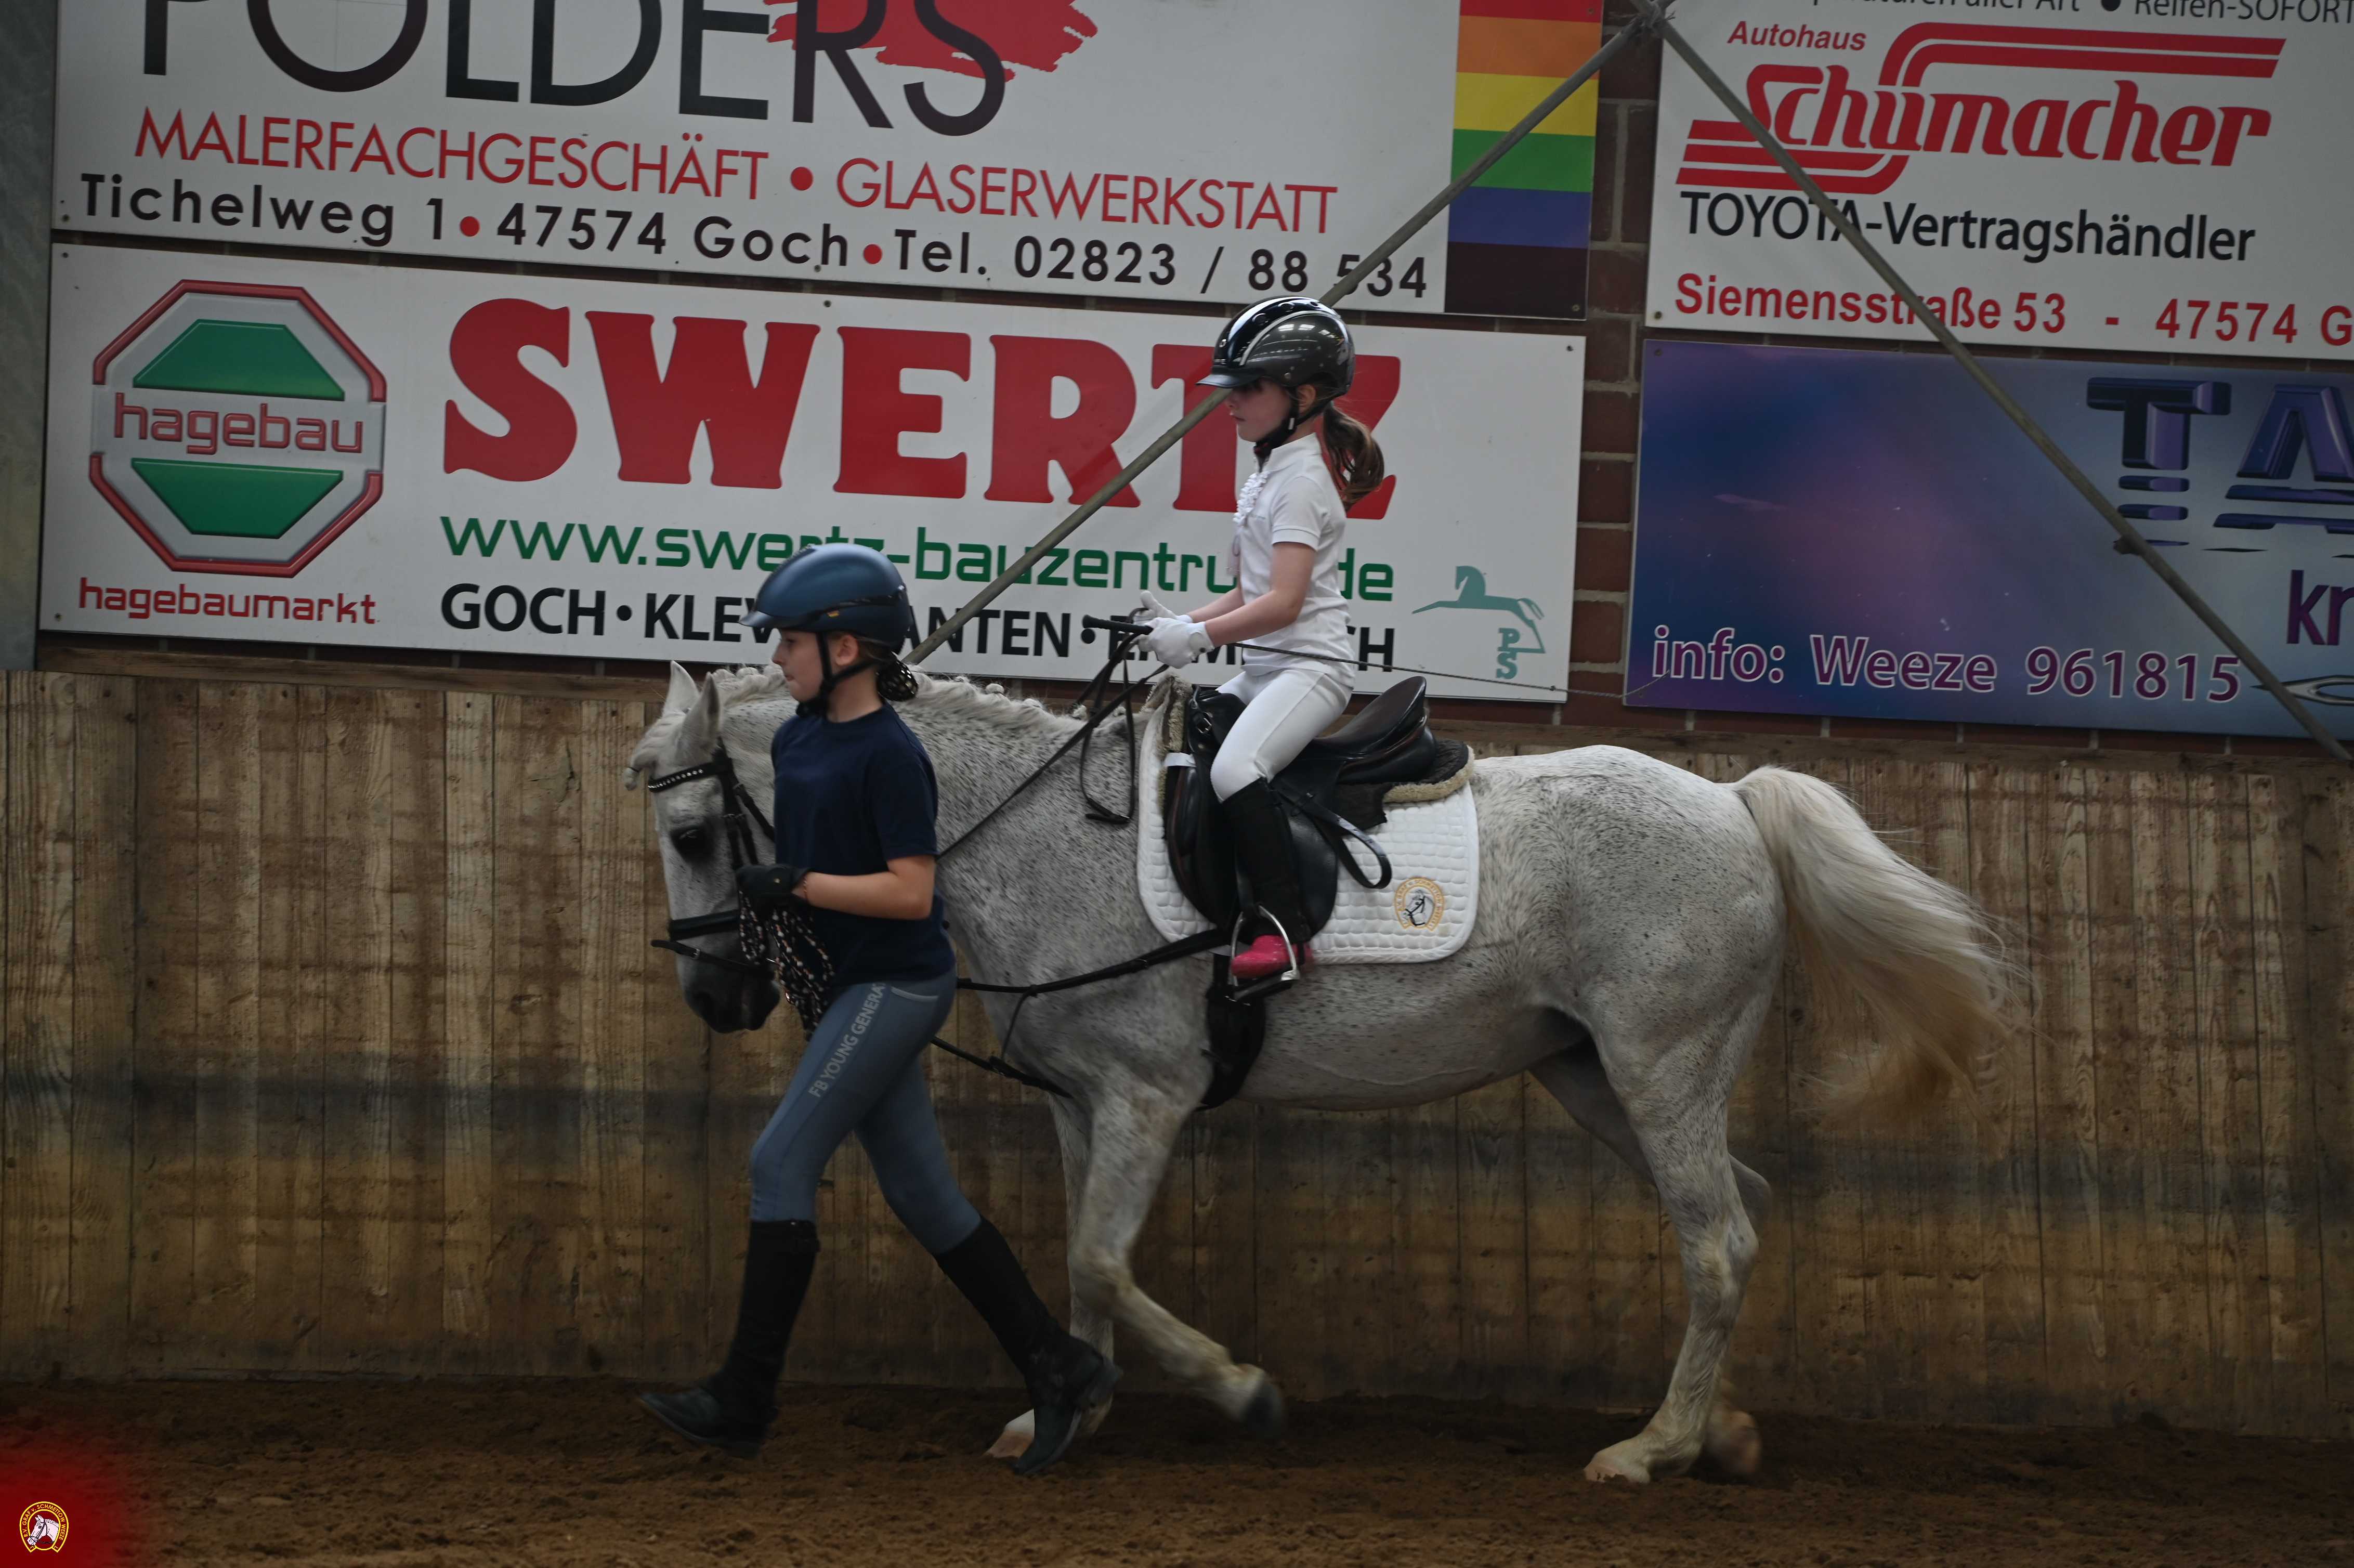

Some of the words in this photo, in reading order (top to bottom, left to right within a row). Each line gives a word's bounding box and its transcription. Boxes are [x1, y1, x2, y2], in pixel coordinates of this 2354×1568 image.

[1727, 20, 1867, 51] Autohaus
[1746, 63, 2272, 167] Schumacher
[135, 106, 769, 200] MALERFACHGESCHÄFT
[836, 158, 1338, 233] GLASERWERKSTATT
[81, 173, 394, 247] Tichelweg
[427, 198, 443, 240] 1
[497, 203, 666, 255] 47574
[694, 216, 848, 267] Goch
[894, 229, 987, 276] Tel.
[1014, 236, 1176, 285] 02823
[1249, 250, 1309, 293] 88
[1333, 254, 1427, 298] 534
[1680, 191, 2256, 263] TOYOTA-Vertragshändler
[2014, 291, 2067, 333] 53
[2155, 298, 2298, 344] 47574
[114, 392, 364, 455] hagebau
[439, 515, 1394, 602] www.swe-bauzentrue
[80, 577, 376, 624] hagebaumarkt
[441, 583, 606, 636] GOCH
[644, 593, 773, 644] KLE
[905, 605, 1071, 658] NTEN
[1652, 625, 1785, 683] info:
[1810, 634, 1997, 692] Weeze
[2026, 646, 2242, 703] 961815
[820, 1034, 858, 1080] YOUNG
[851, 983, 886, 1035] GENERA
